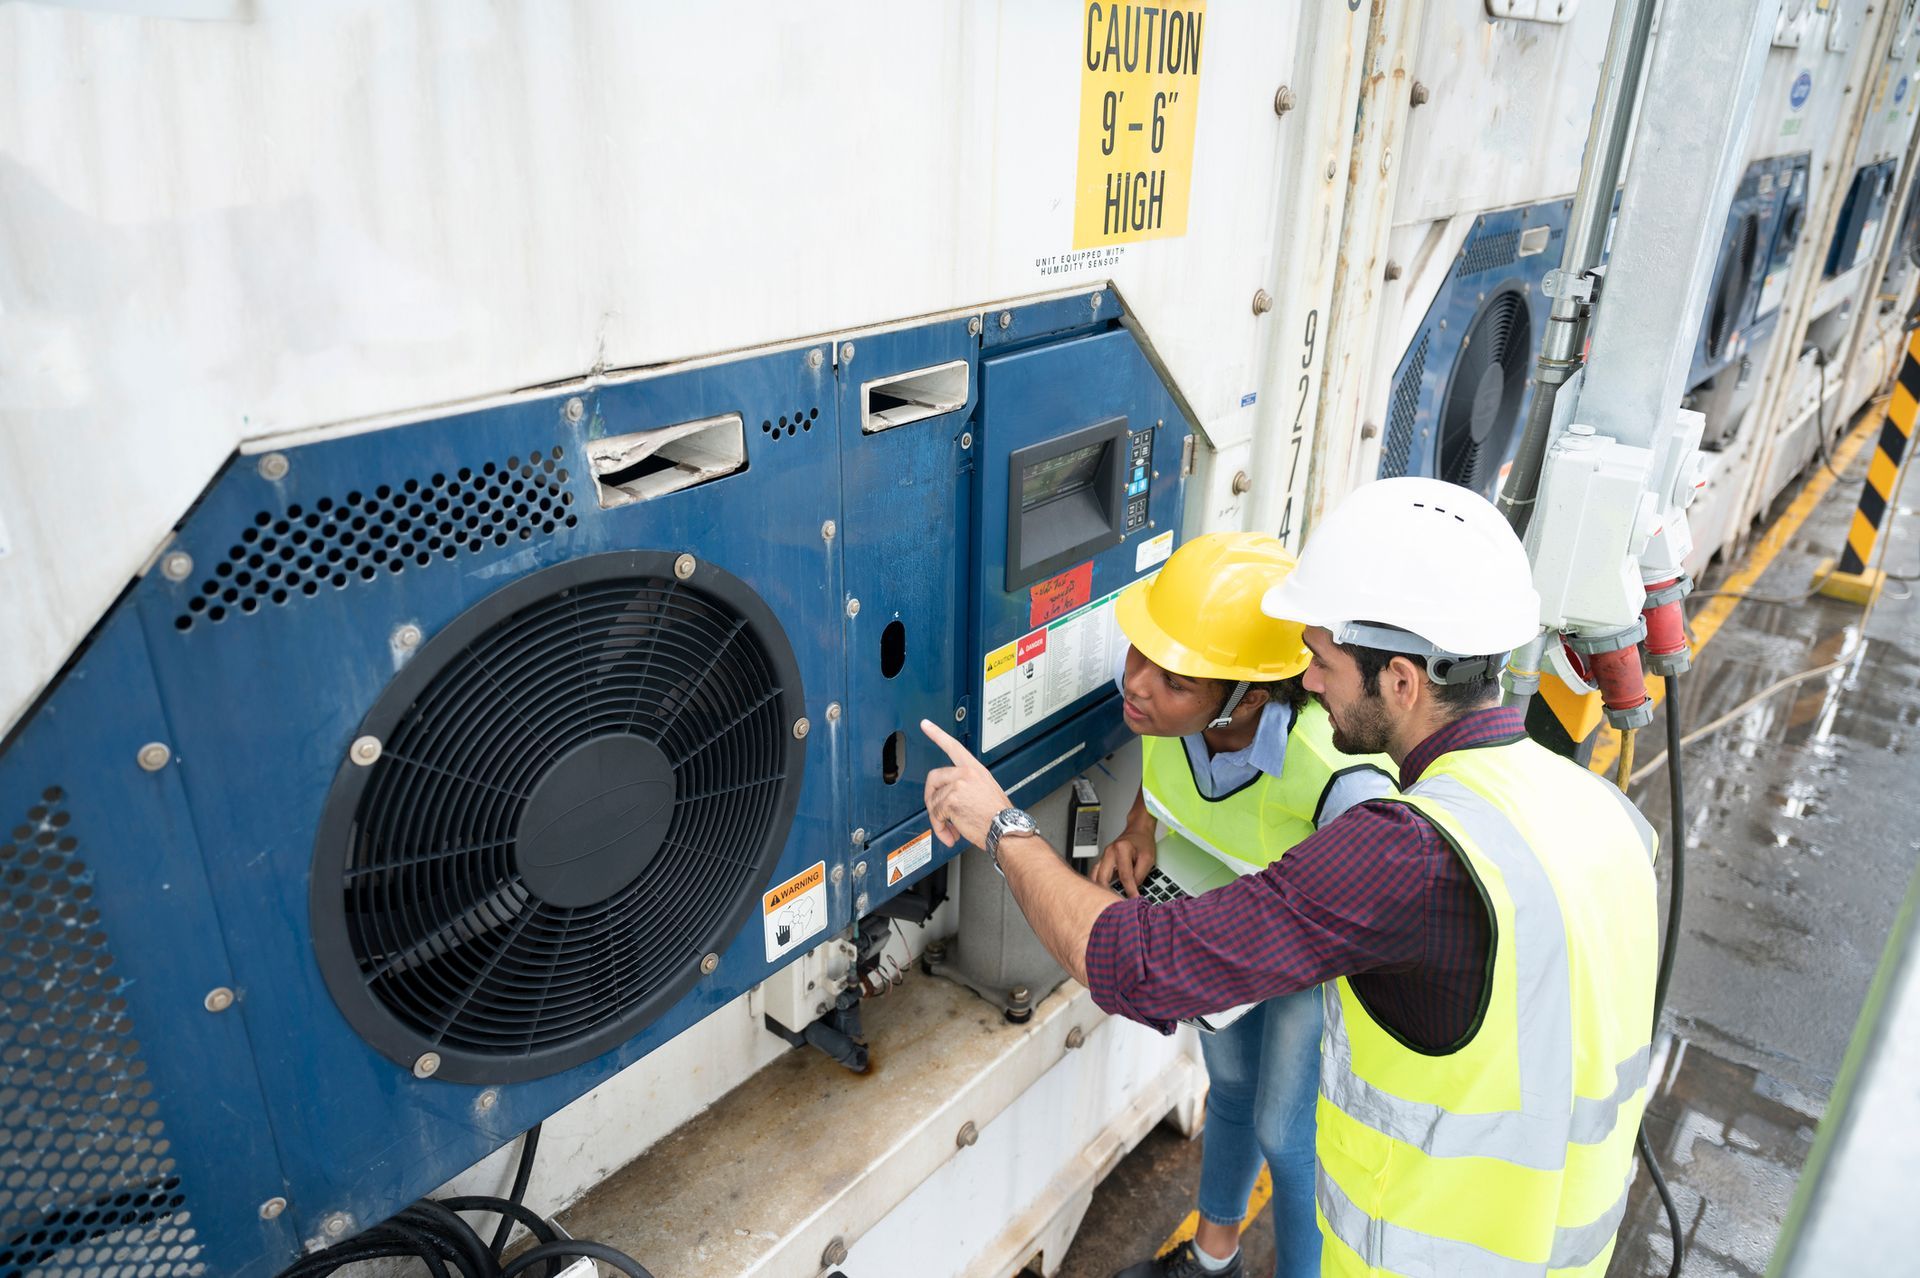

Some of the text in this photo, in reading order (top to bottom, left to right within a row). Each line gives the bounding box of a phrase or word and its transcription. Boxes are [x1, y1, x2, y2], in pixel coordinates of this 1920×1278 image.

[1086, 1, 1203, 76] CAUTION
[1104, 170, 1166, 235] HIGH
[1035, 247, 1125, 267] UNIT EQUIPPED WITH
[1040, 257, 1120, 276] HUMIDITY SENSOR
[780, 871, 819, 900] WARNING
